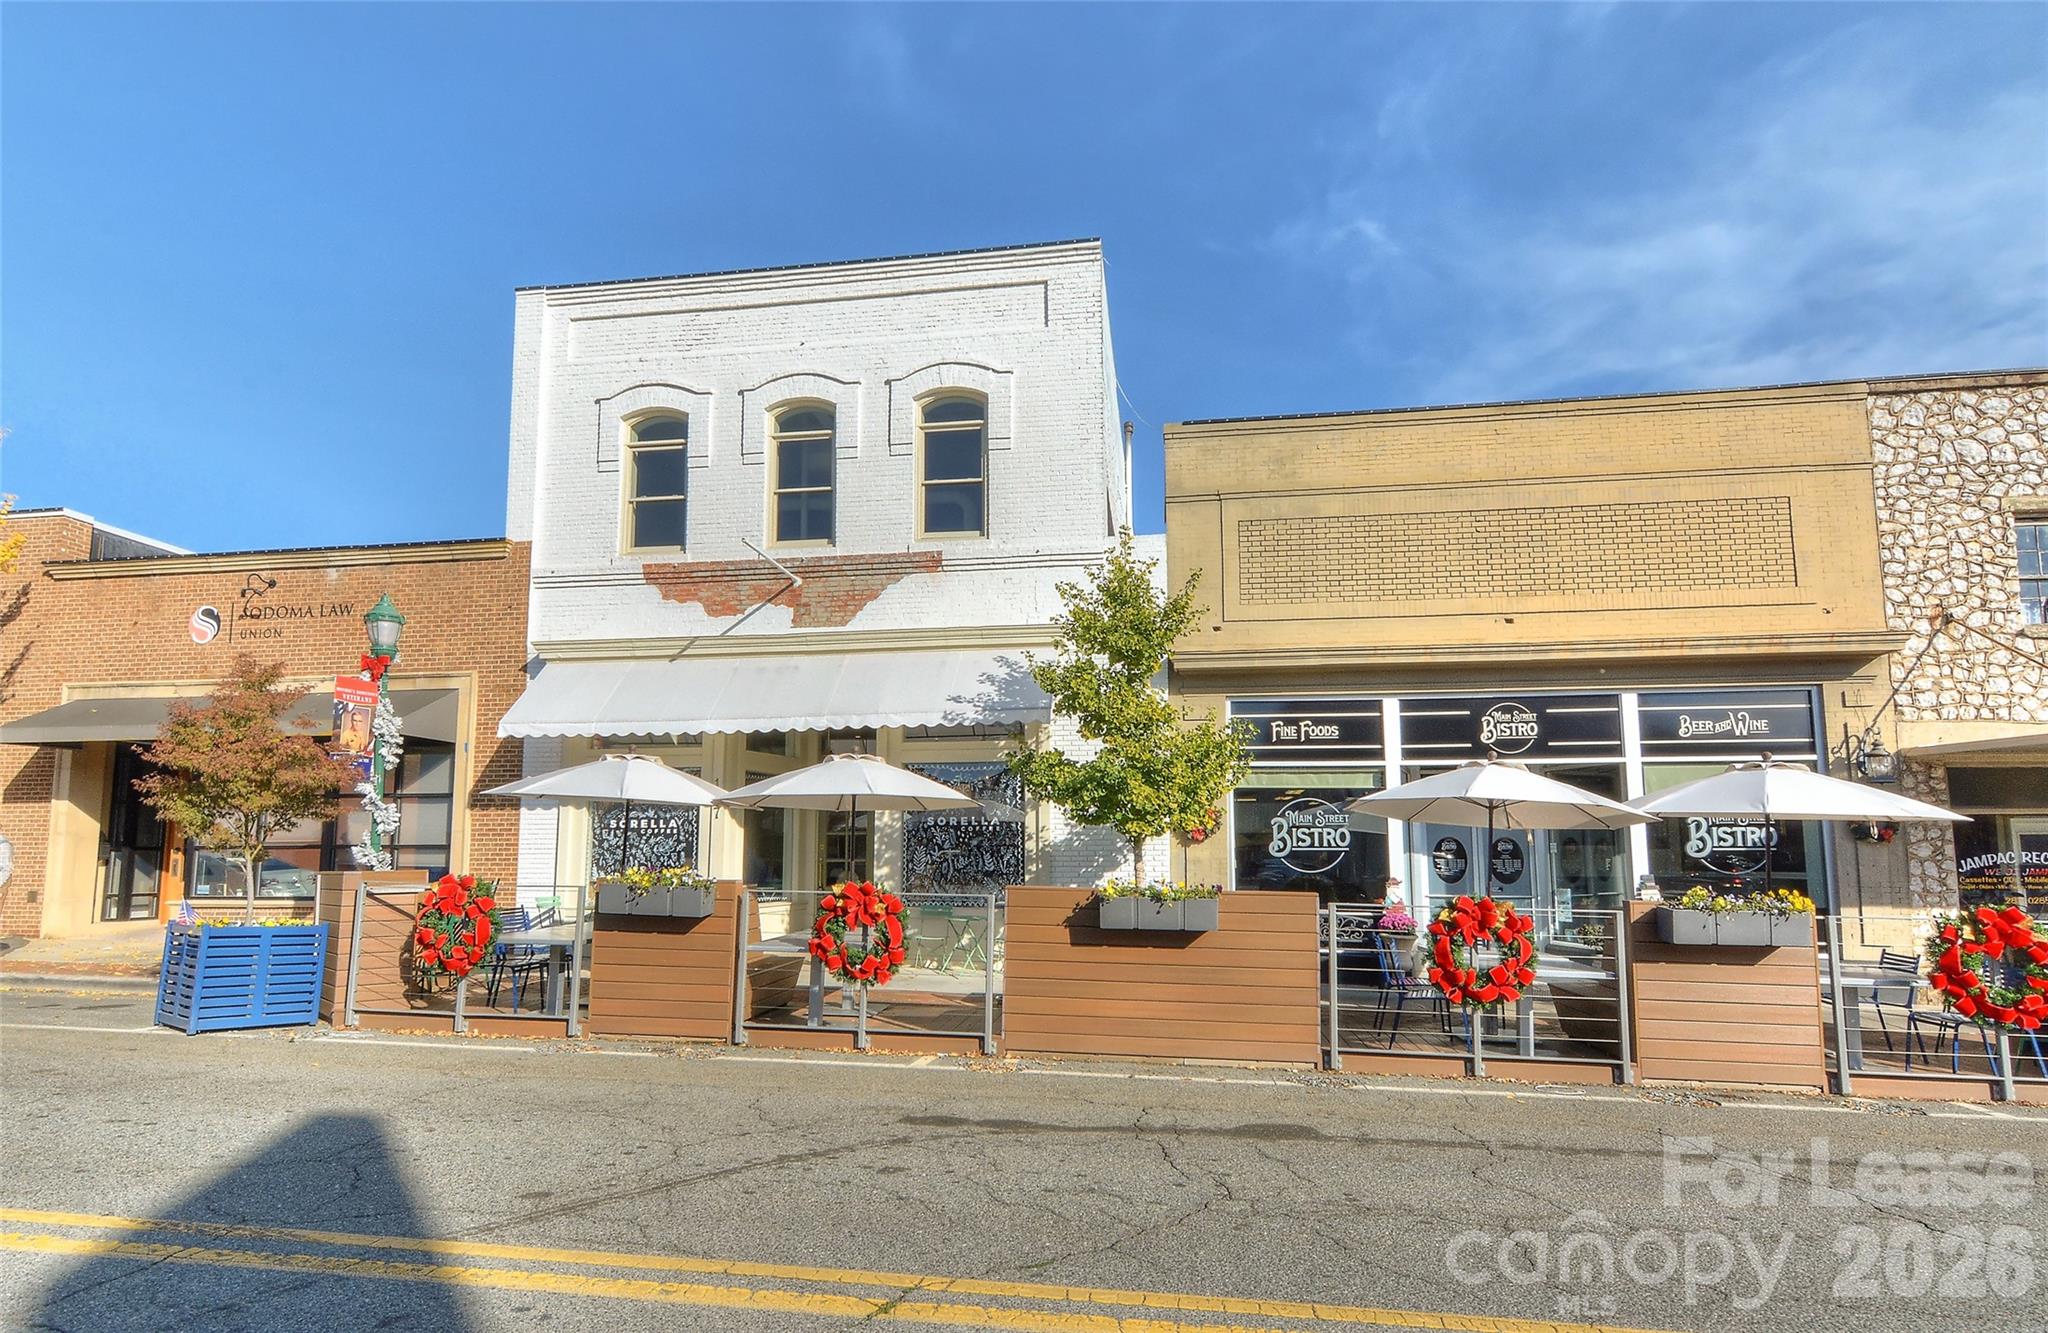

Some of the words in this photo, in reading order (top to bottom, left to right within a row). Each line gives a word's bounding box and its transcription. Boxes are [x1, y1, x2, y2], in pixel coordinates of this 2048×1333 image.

[320, 603, 354, 618] LAW
[240, 628, 282, 640] UNION
[609, 819, 678, 829] SORELLA
[927, 816, 1000, 826] SORELLA
[1958, 851, 2016, 873] JAMPAC
